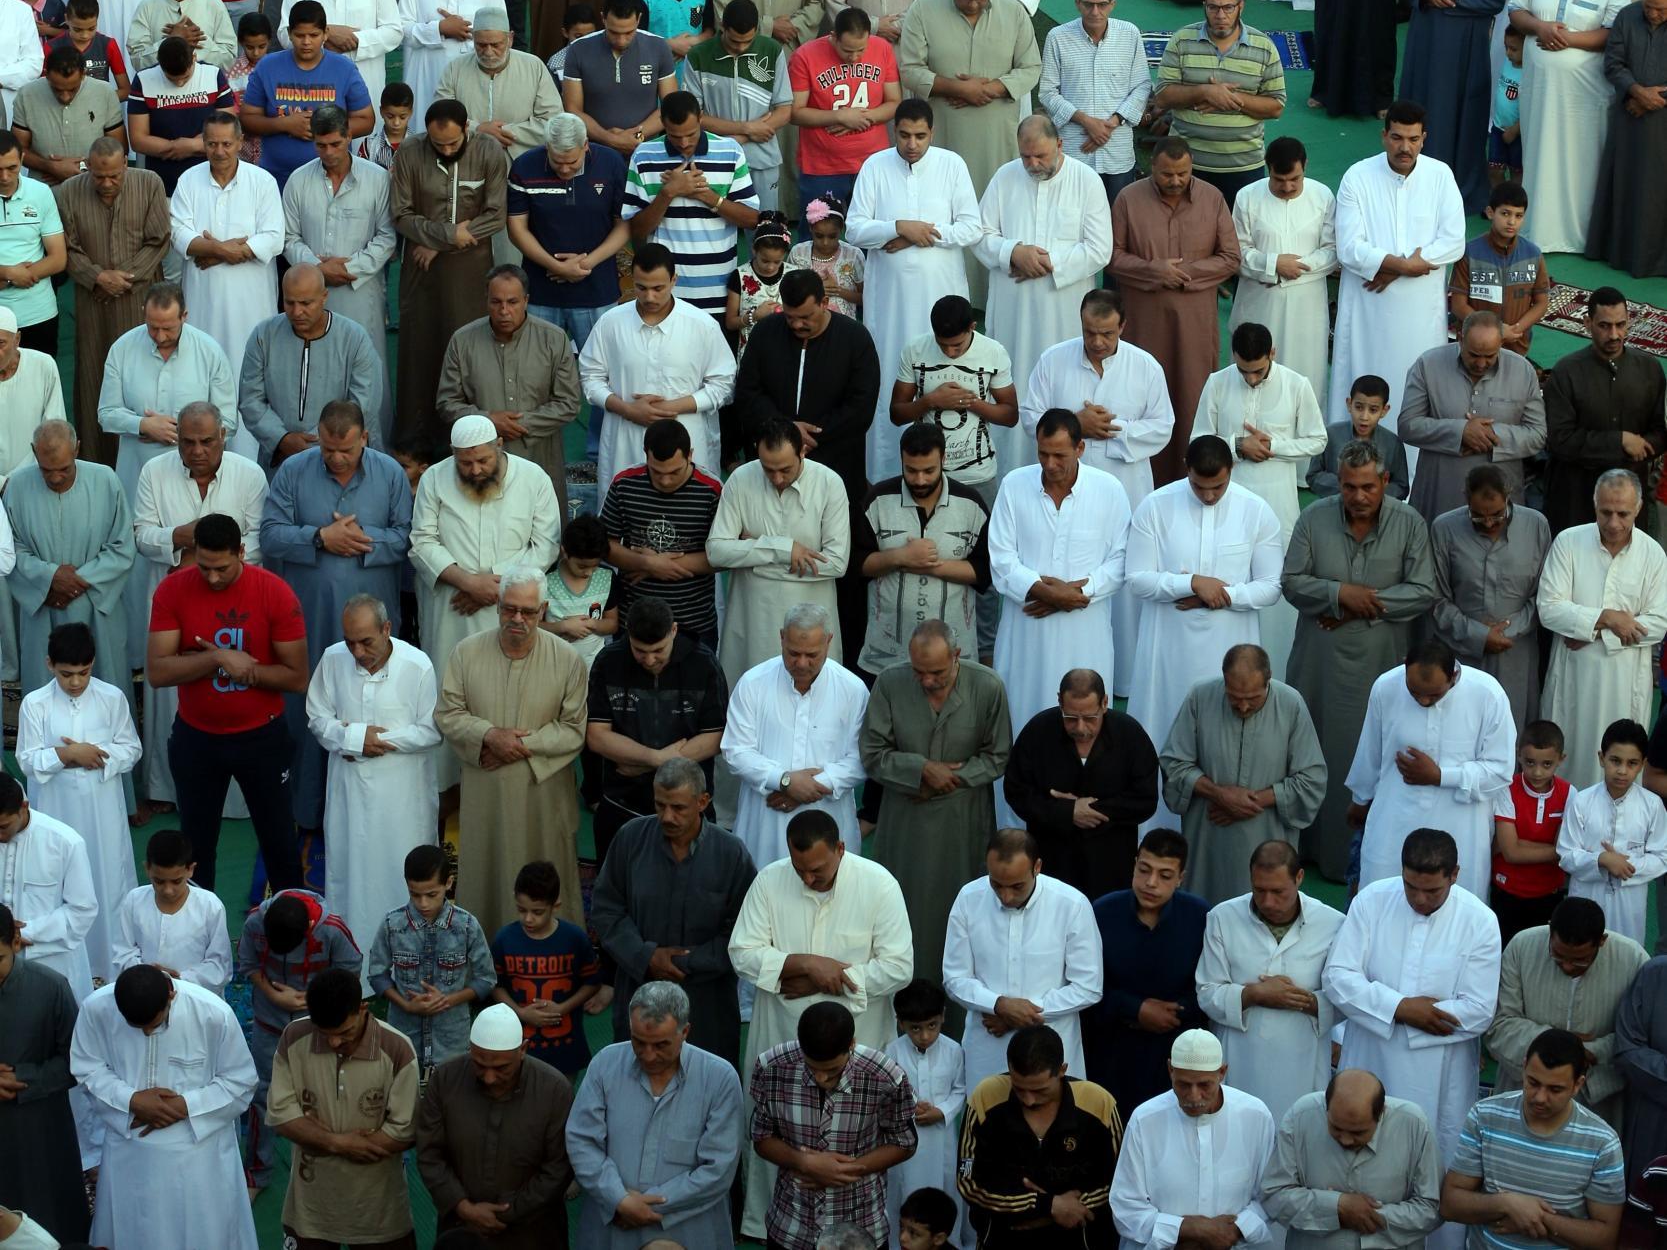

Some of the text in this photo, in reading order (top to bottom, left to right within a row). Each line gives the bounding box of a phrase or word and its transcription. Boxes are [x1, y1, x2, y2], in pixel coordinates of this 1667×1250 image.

[641, 75, 652, 85] 63
[816, 62, 882, 90] HILFIGER
[275, 83, 337, 102] MOSCHINO
[833, 82, 869, 111] 24
[505, 954, 575, 974] DETROIT
